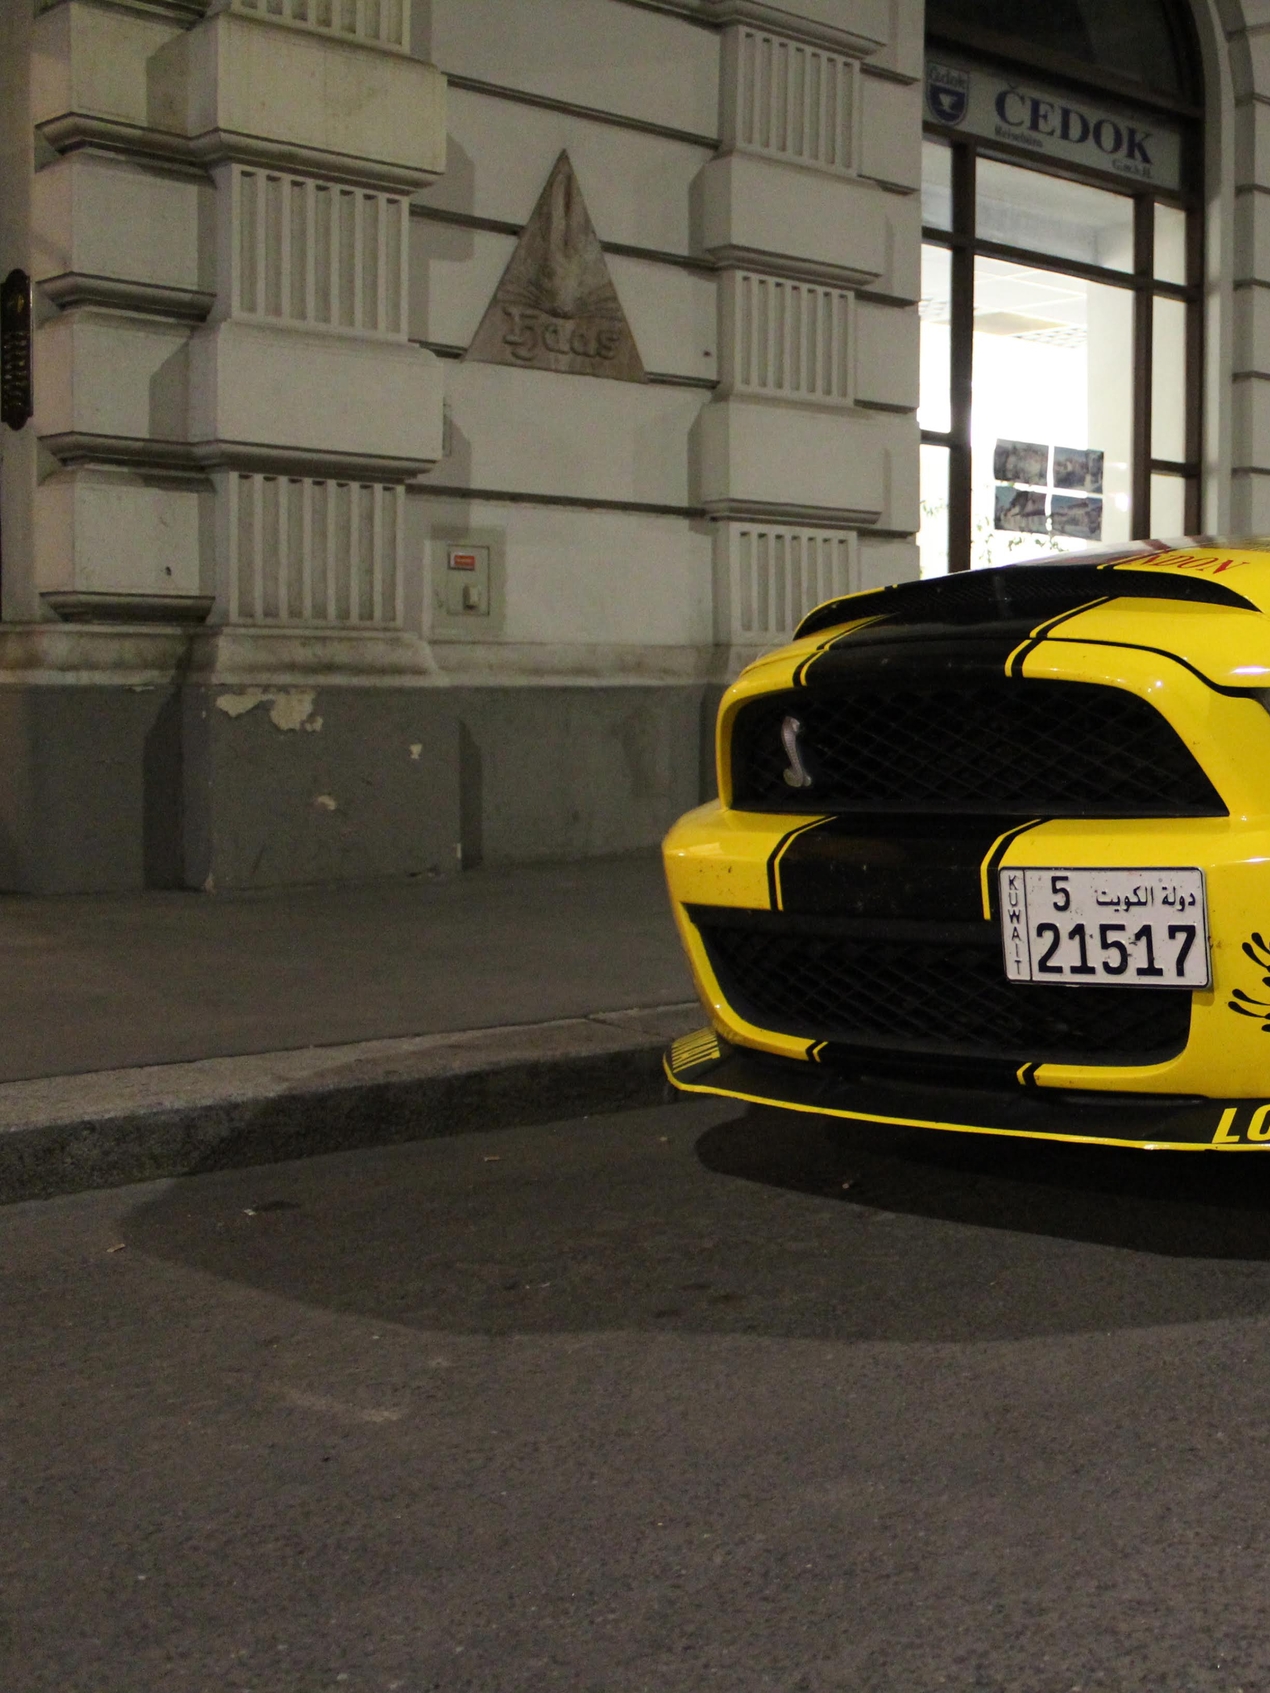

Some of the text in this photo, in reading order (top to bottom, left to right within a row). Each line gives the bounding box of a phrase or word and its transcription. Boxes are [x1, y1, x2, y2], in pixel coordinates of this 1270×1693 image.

[994, 82, 1153, 165] ČEDOK
[1051, 875, 1071, 912] 5
[1096, 884, 1196, 912] دولة الكويت
[1008, 875, 1022, 976] KUWAIT
[1036, 922, 1197, 977] 21517
